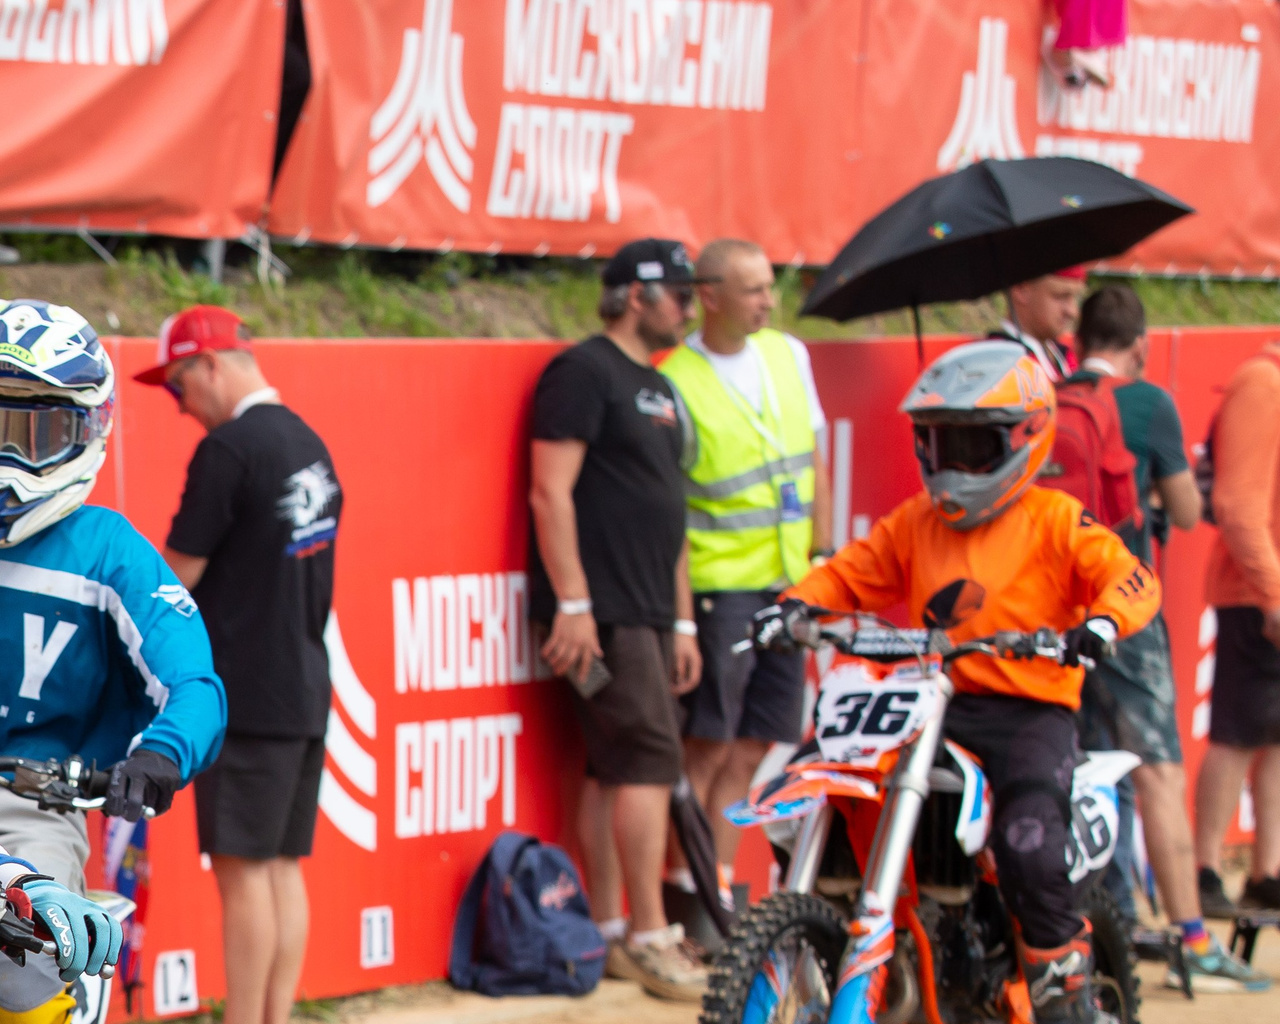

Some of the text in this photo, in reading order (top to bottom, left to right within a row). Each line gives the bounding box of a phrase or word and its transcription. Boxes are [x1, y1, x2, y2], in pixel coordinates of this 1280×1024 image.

[486, 103, 634, 223] СПОРТ
[393, 571, 527, 693] МОСКО
[821, 692, 919, 739] 36
[395, 713, 522, 839] СПОРТ
[162, 956, 193, 1006] 12
